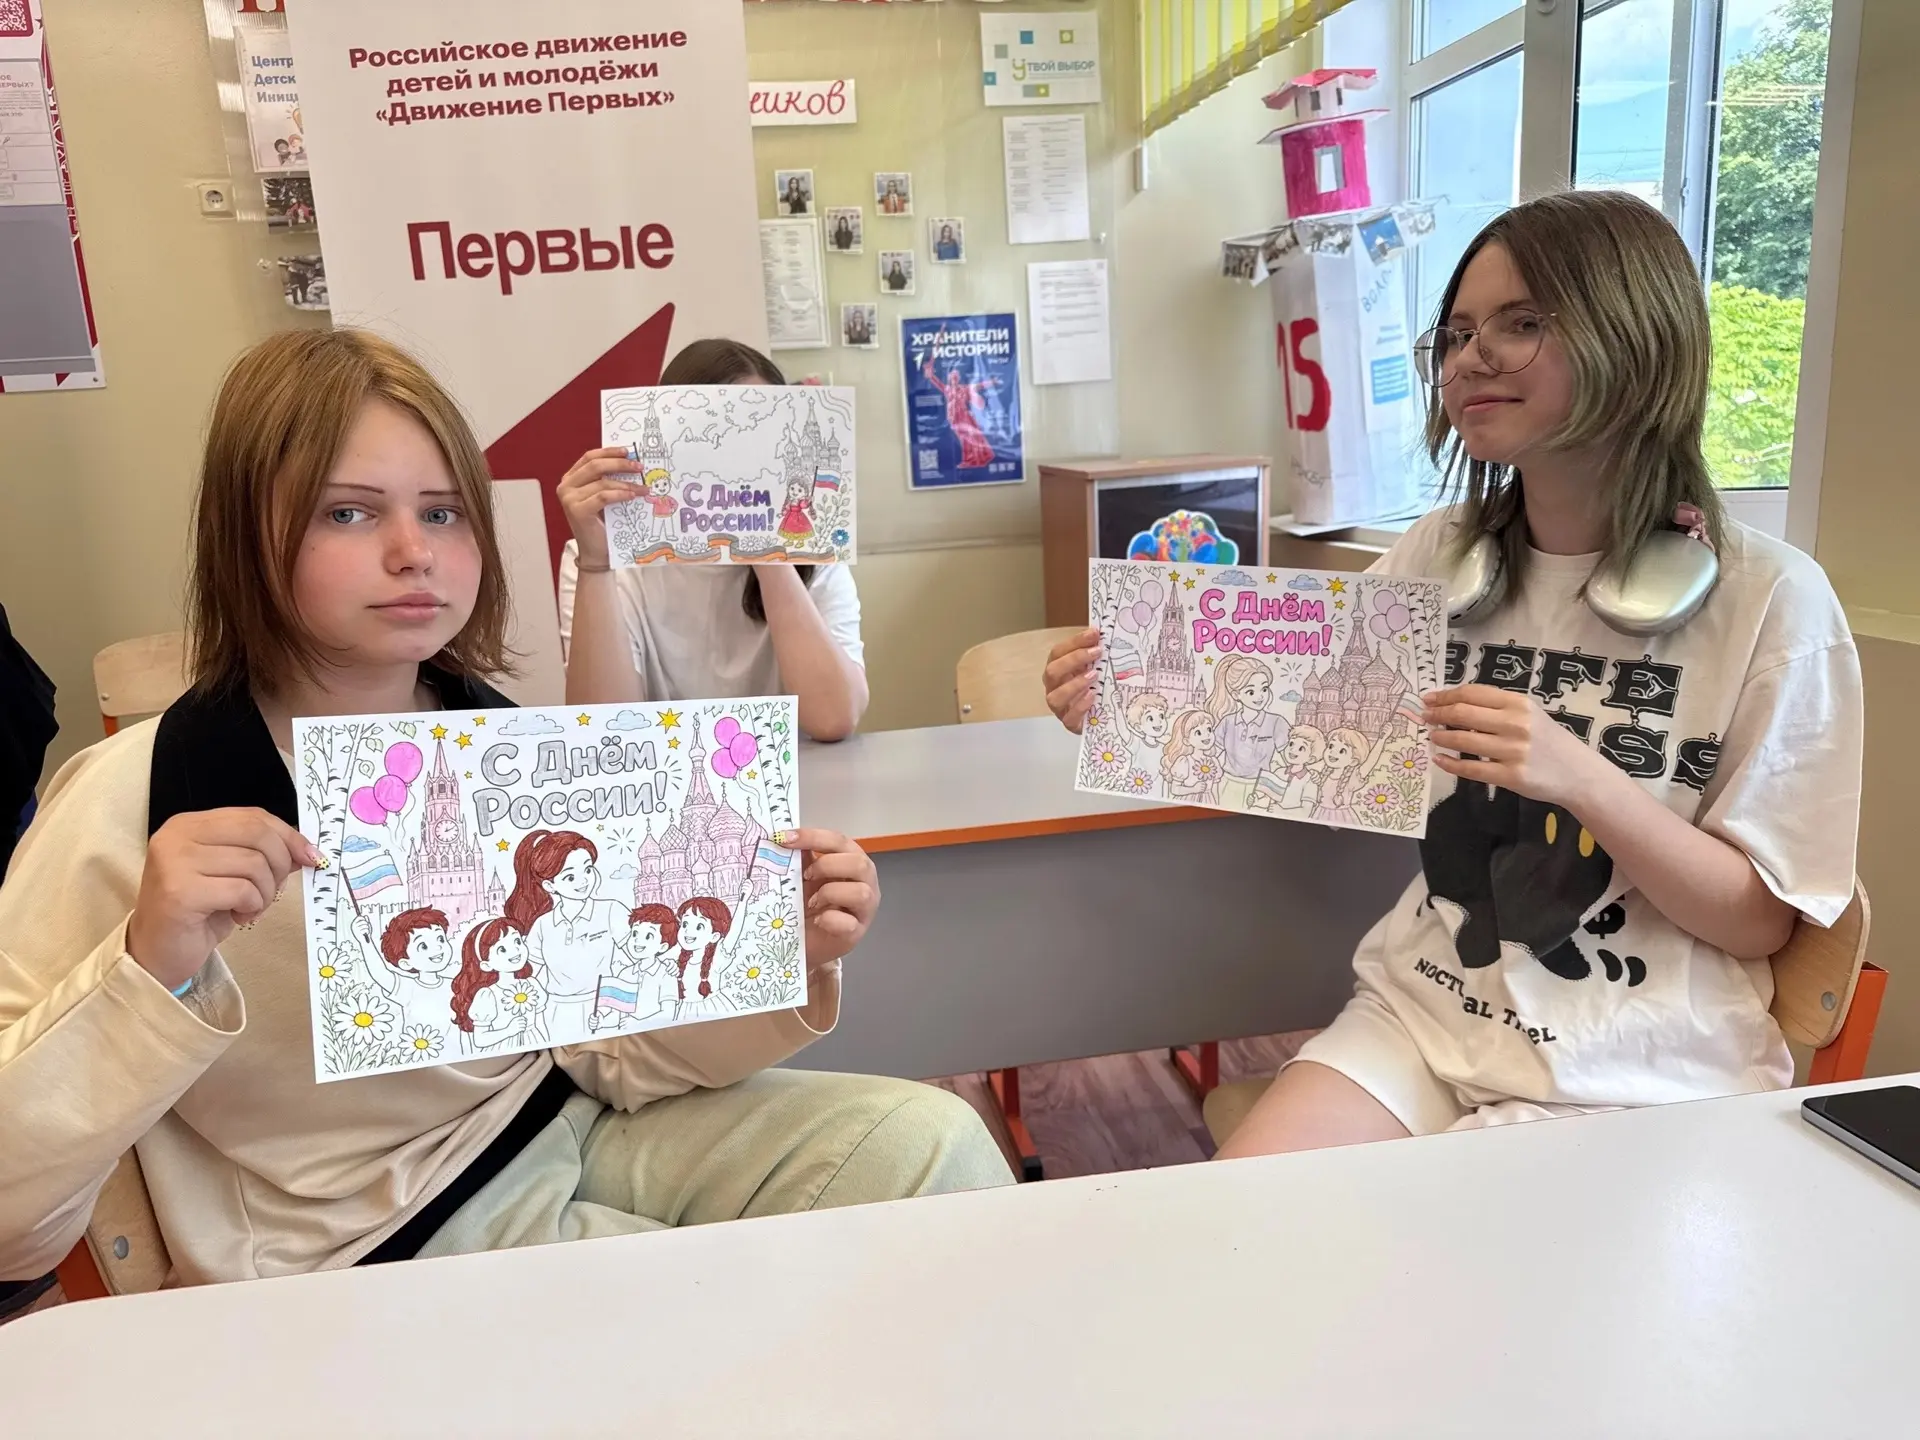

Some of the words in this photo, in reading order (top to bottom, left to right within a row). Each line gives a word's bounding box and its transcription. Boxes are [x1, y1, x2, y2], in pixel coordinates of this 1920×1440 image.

[251, 55, 294, 68] Центр
[349, 40, 529, 68] Российское
[536, 28, 688, 60] движение
[1027, 60, 1056, 72] ТВОЙ
[1057, 60, 1096, 71] ВЫБОР
[254, 74, 297, 87] Детск
[387, 68, 473, 97] детей
[479, 72, 497, 88] и
[504, 61, 659, 87] молодёжи
[376, 97, 542, 126] «Движение
[548, 90, 675, 116] Первых»
[407, 221, 675, 296] Первые
[911, 328, 1010, 346] ХРАНИТЕЛИ
[932, 342, 1010, 359] ИСТОРИИ
[1277, 317, 1331, 432] 15
[683, 482, 703, 507] С
[707, 484, 772, 512] Днём
[680, 507, 775, 534] России!
[1199, 588, 1226, 620] С
[1232, 592, 1326, 624] Днём
[1191, 618, 1334, 658] России!
[480, 742, 521, 785] С
[531, 735, 658, 788] Днём
[471, 770, 669, 837] России!
